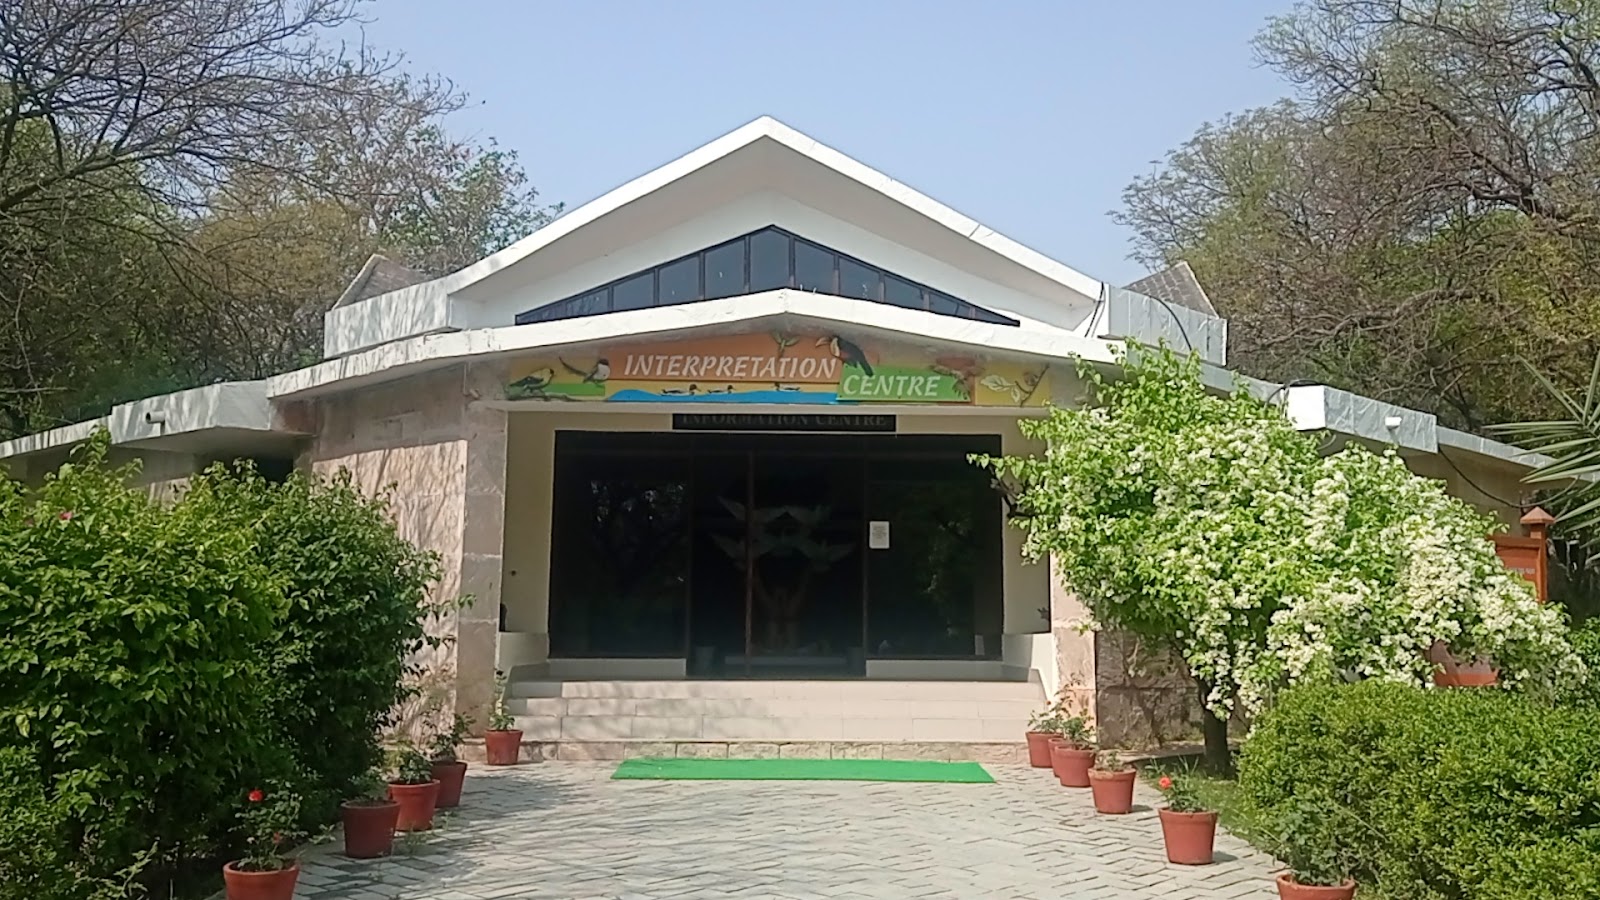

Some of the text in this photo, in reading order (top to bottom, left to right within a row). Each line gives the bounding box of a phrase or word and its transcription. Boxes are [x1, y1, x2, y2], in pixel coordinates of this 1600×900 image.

[624, 354, 837, 379] INTERPRETATION
[843, 374, 941, 397] CENTRE
[682, 414, 887, 426] INFORMATION CENTRE
